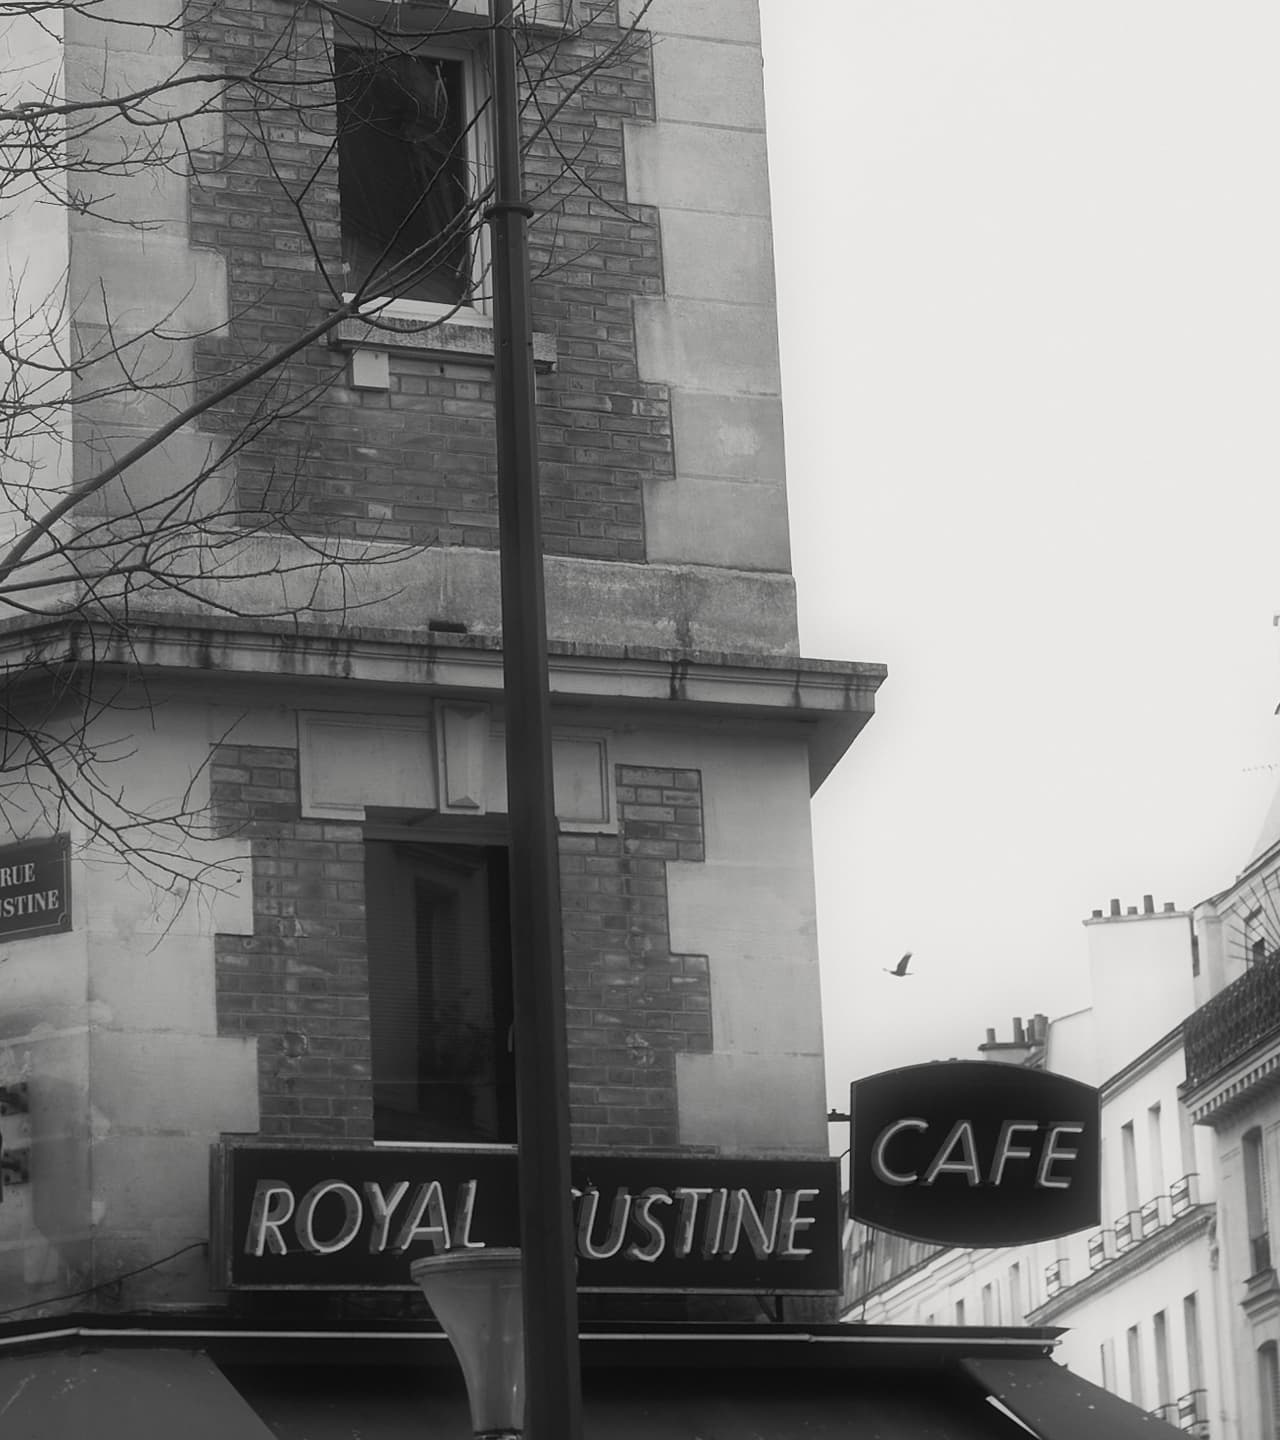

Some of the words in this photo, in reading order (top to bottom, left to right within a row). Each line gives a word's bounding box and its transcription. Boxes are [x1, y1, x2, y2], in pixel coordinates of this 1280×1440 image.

[871, 1116, 1085, 1189] CAFE
[243, 1178, 486, 1257] ROYAL
[571, 1184, 821, 1262] USTINE
